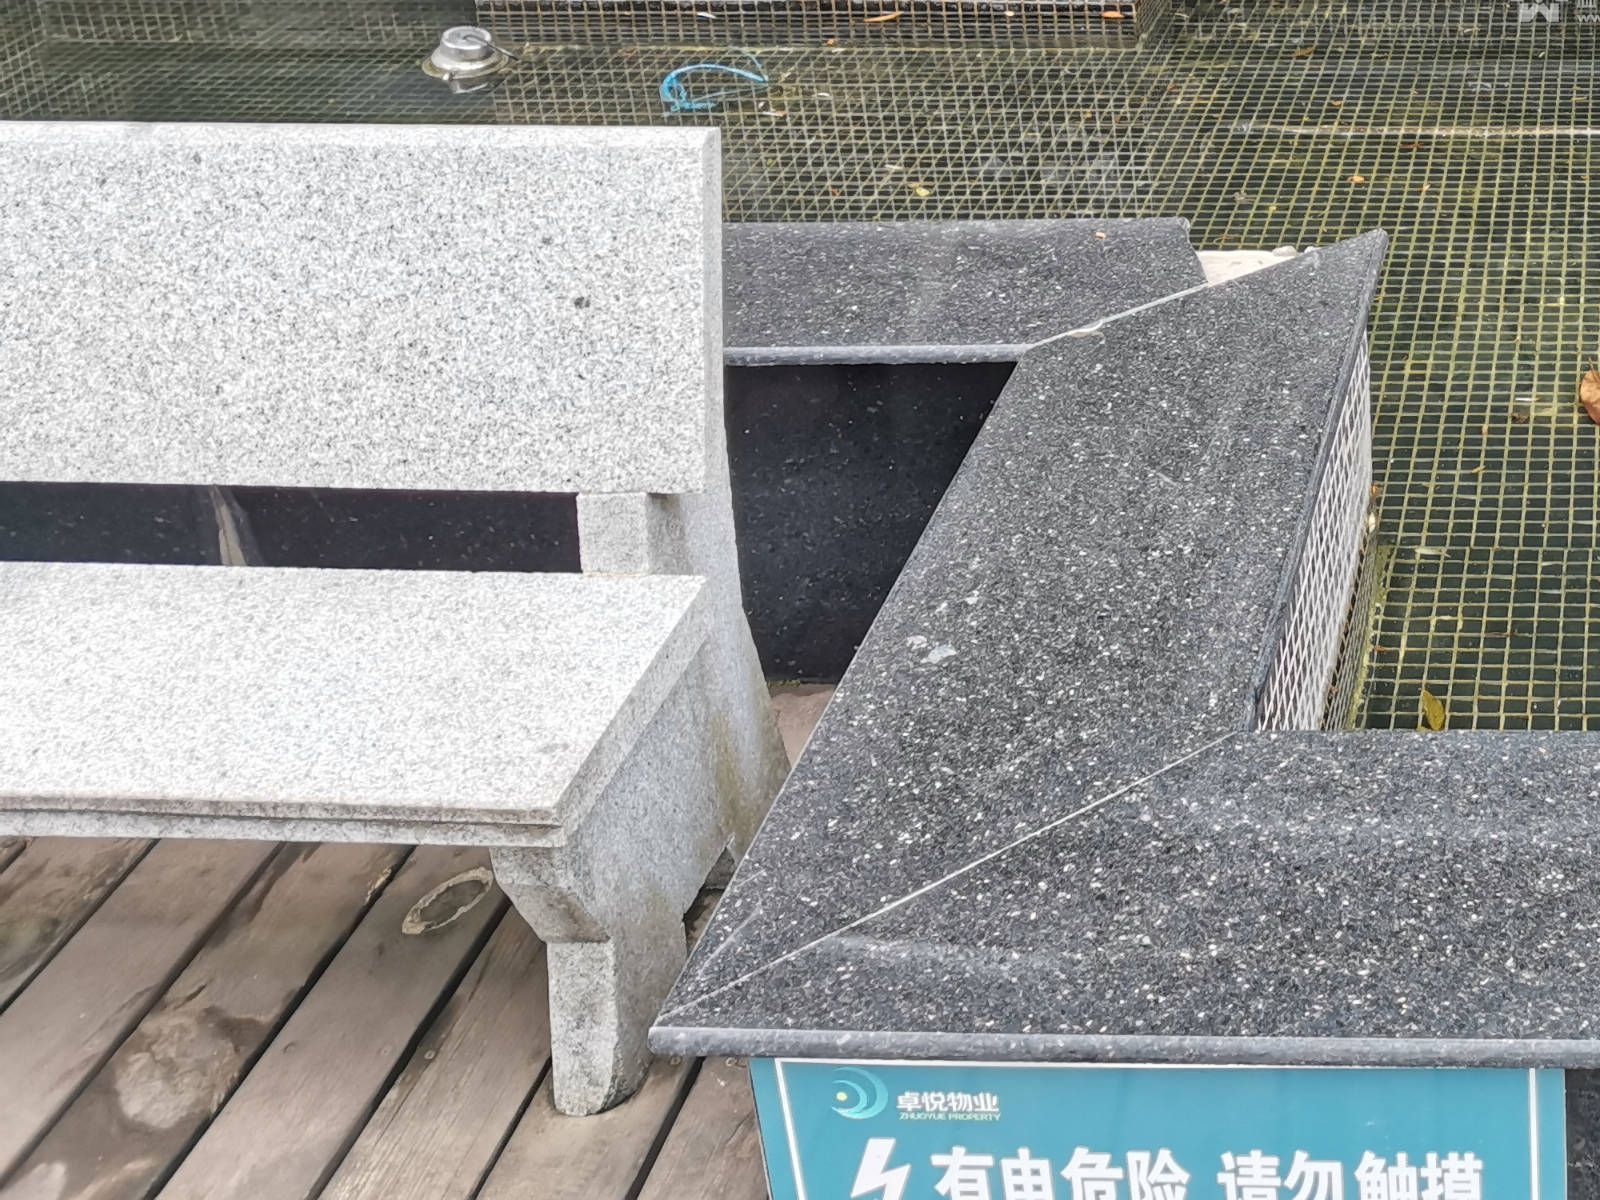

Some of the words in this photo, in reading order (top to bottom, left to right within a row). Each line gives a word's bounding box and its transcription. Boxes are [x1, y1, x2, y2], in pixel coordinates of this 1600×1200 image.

[896, 1090, 1000, 1112] 卓悦物业
[898, 1111, 946, 1121] ZHUOYUE
[948, 1111, 1001, 1121] PROPERTY
[930, 1146, 1191, 1200] 有电危险
[1217, 1150, 1485, 1200] 请勿触摸
